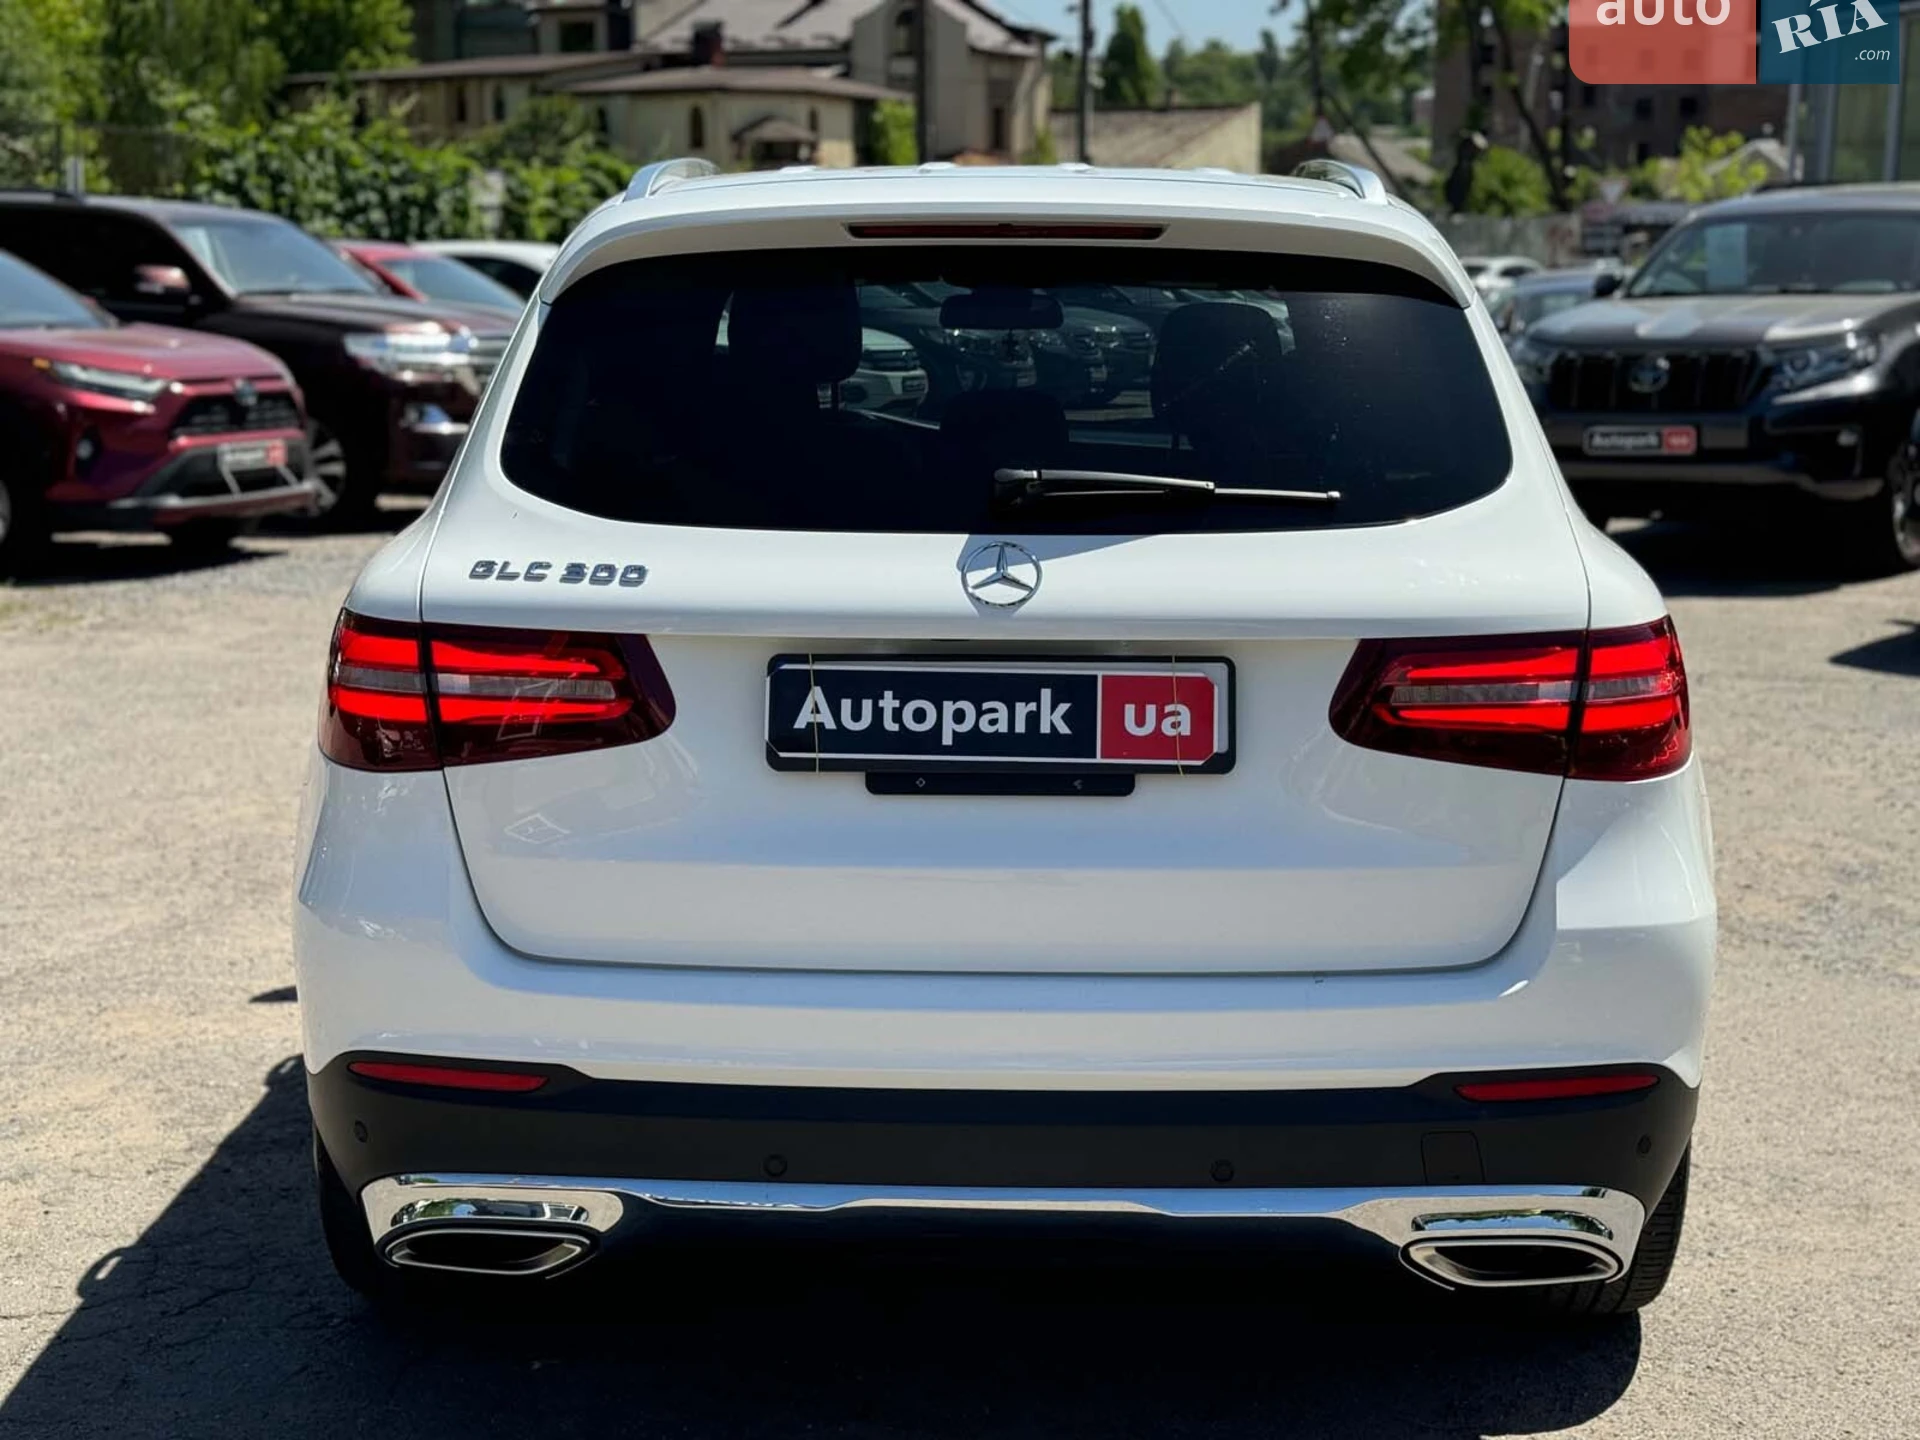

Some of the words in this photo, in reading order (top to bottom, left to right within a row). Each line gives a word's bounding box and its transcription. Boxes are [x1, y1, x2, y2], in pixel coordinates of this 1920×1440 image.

[468, 560, 553, 582] GLC
[559, 562, 649, 587] 300
[793, 685, 1073, 746] Autopark
[1123, 702, 1192, 737] ua
